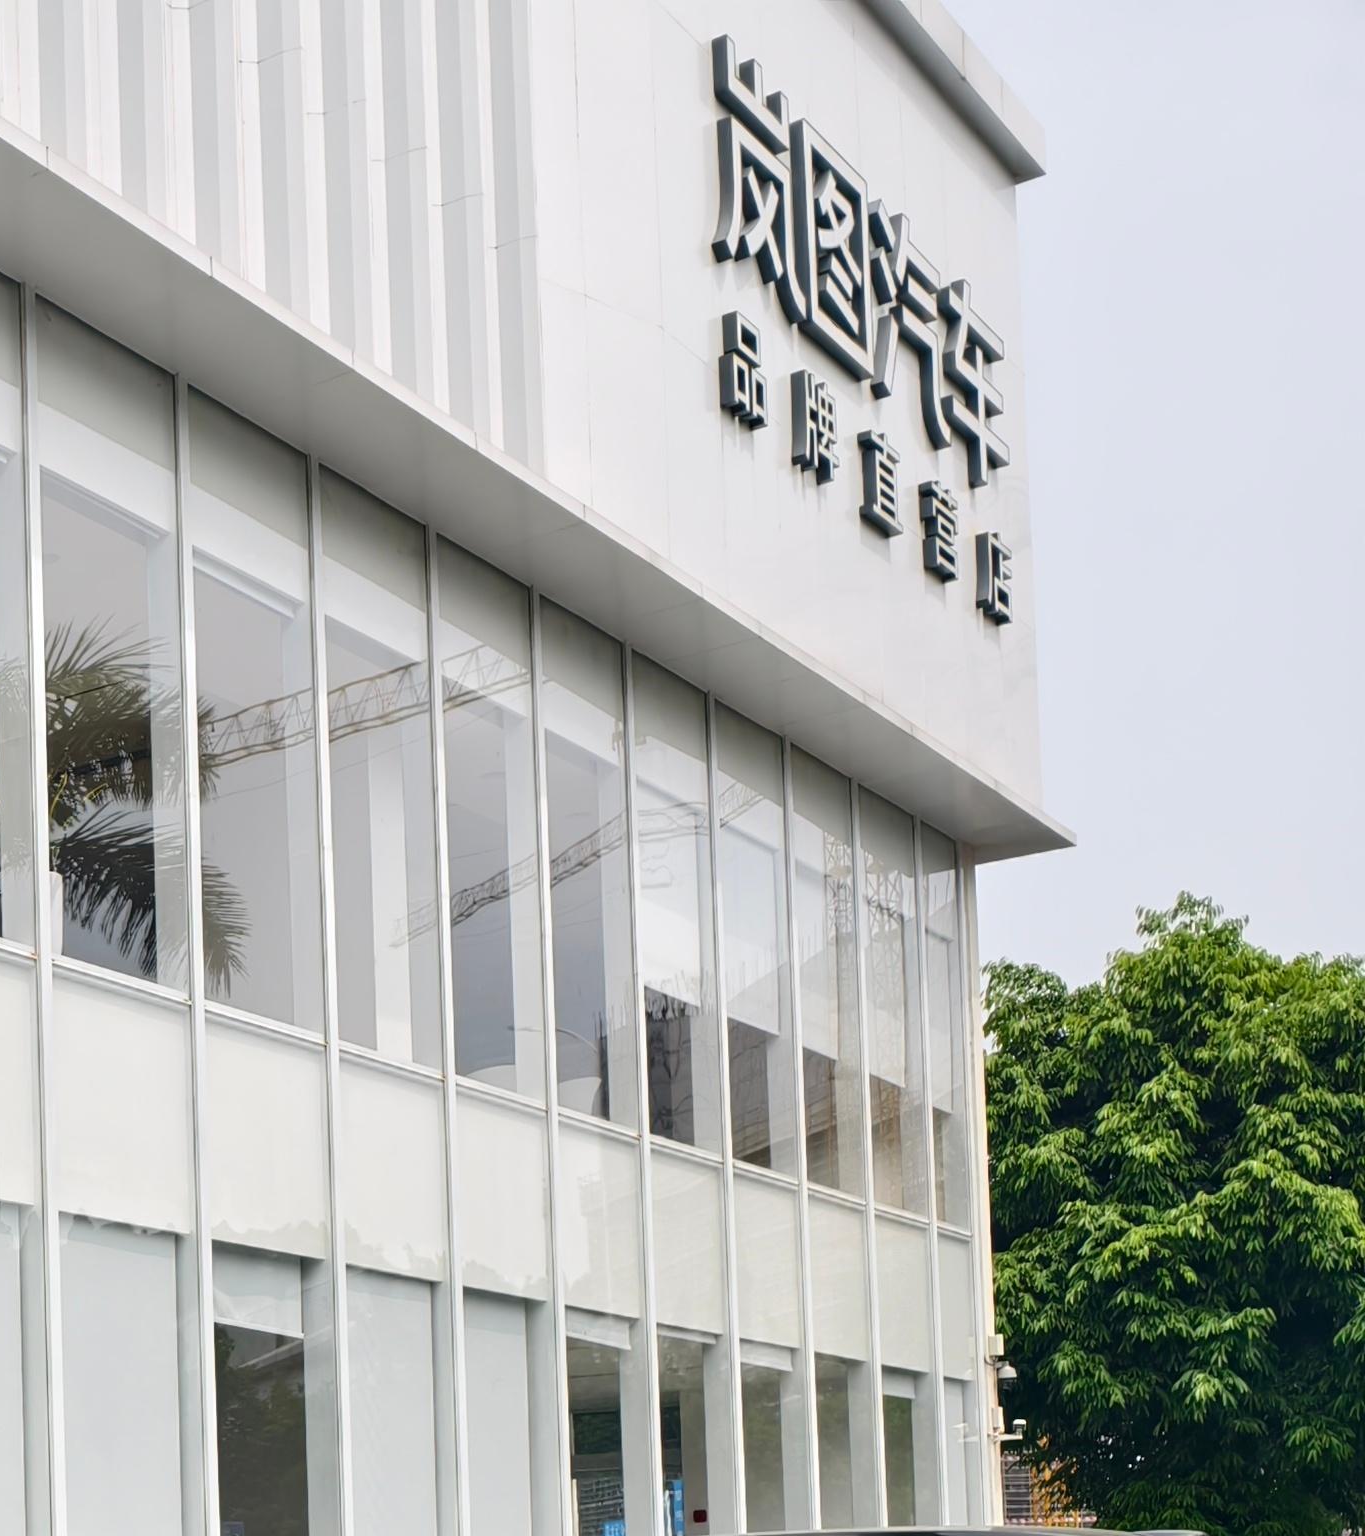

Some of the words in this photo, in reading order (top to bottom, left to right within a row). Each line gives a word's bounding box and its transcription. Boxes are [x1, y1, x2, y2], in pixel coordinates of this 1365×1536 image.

[712, 34, 1009, 488] 岚图汽车
[718, 311, 1013, 625] 品牌直营店
